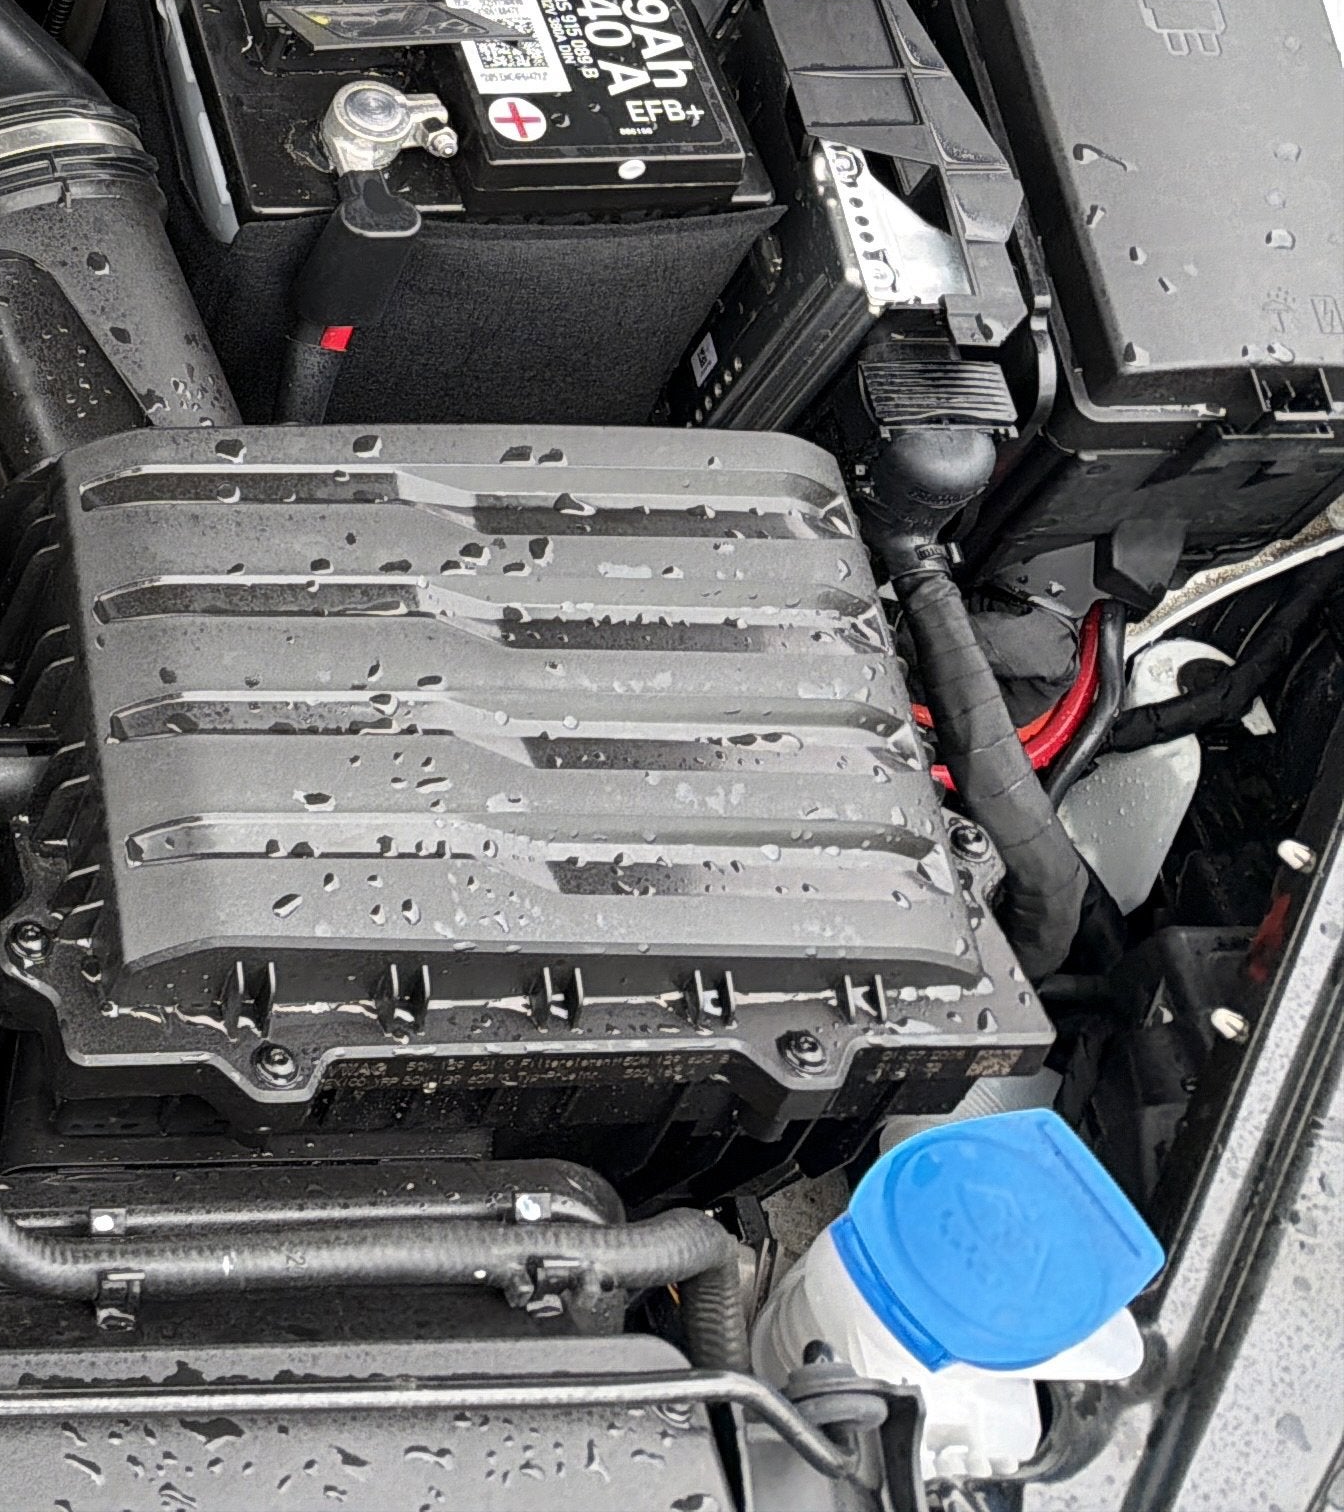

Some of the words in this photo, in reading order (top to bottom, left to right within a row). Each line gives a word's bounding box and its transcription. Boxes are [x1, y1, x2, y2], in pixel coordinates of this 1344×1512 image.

[560, 13, 583, 39] 915
[547, 16, 564, 44] 380A
[558, 44, 577, 65] DIN
[570, 39, 594, 65] 089
[581, 65, 600, 80] B
[597, 59, 652, 96] A
[625, 98, 705, 123] EFB+
